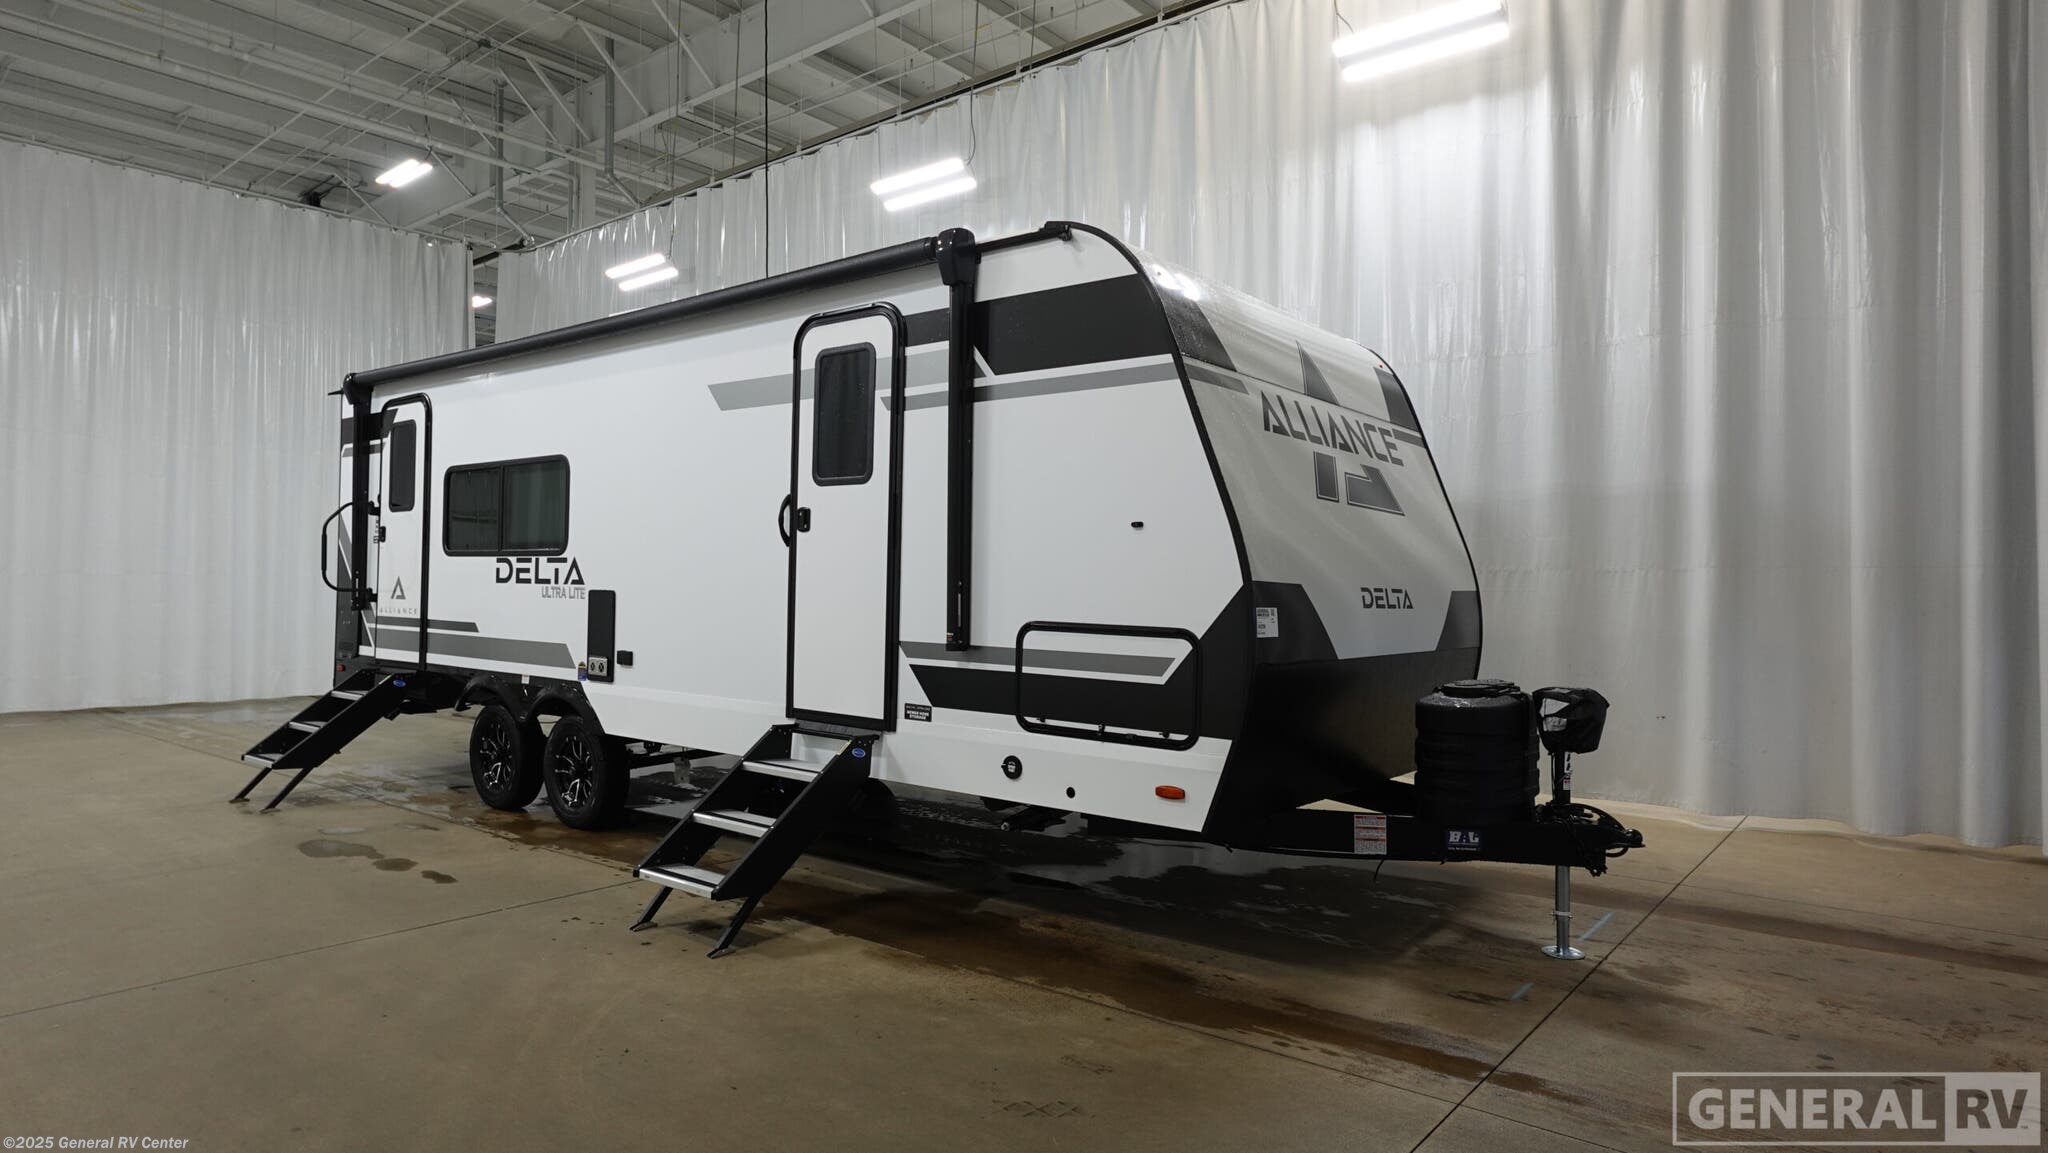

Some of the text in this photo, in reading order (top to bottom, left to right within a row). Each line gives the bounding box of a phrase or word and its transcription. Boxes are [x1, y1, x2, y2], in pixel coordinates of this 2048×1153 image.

[1261, 390, 1404, 467] ALLIANCE
[496, 556, 585, 585] DELTA
[541, 585, 585, 600] ULTRA LITE
[1360, 587, 1414, 609] DELTA
